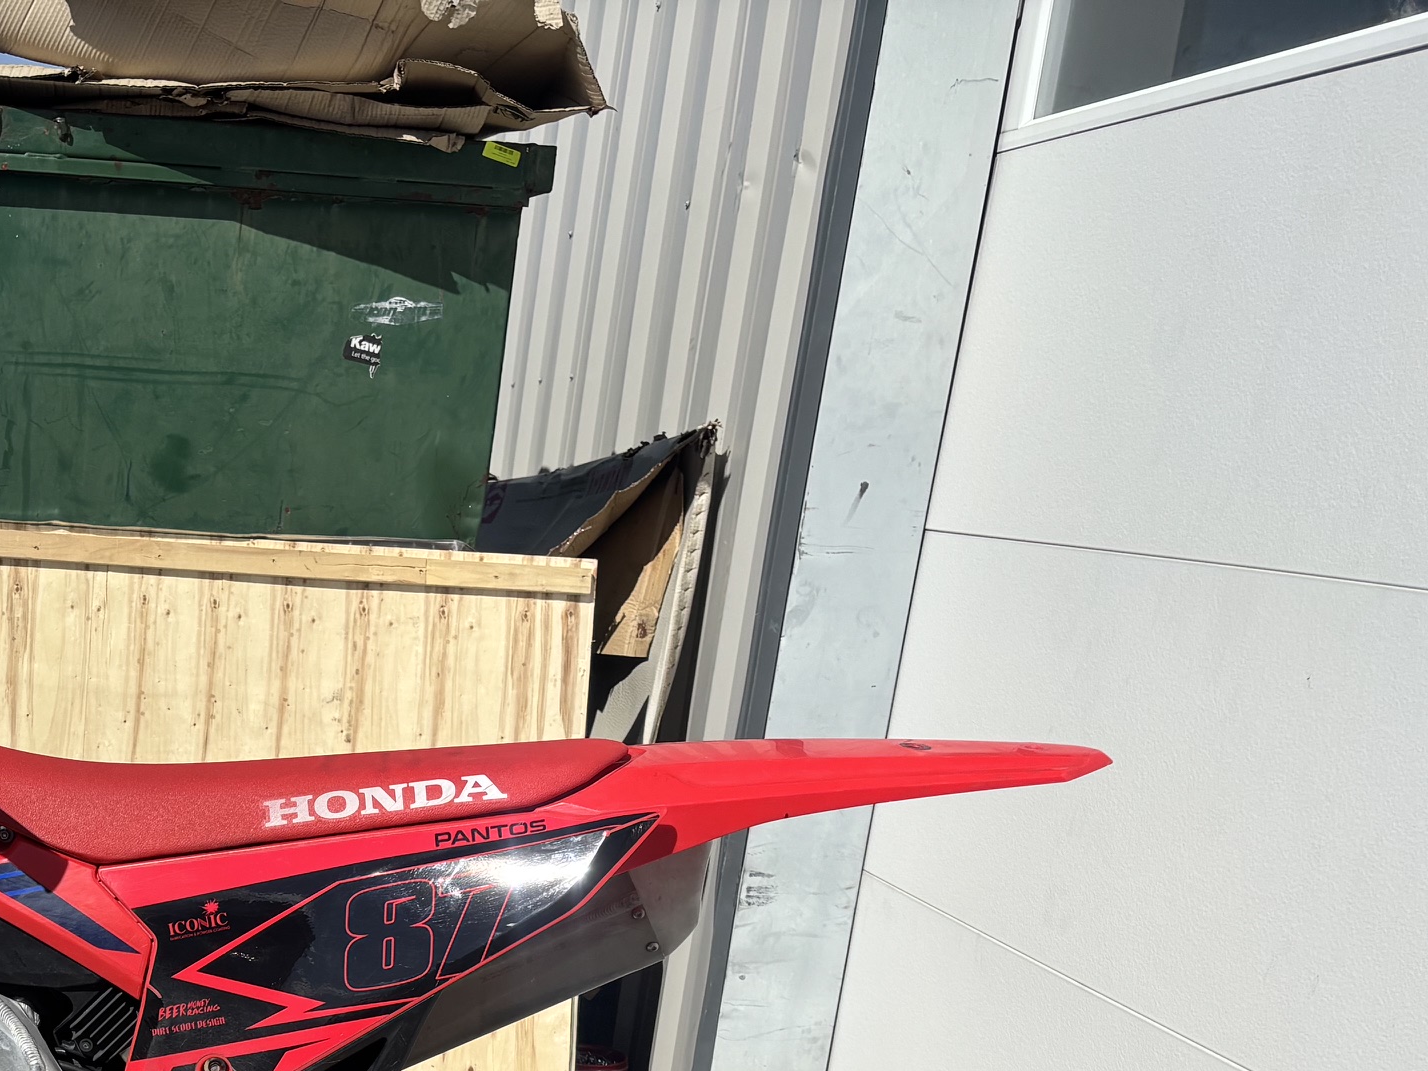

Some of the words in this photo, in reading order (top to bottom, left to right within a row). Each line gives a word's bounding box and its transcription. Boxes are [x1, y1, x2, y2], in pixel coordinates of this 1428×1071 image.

[264, 774, 507, 828] HONDA
[434, 819, 548, 848] PANTOS
[168, 912, 229, 936] ICONIC
[344, 878, 515, 992] 87
[158, 1003, 188, 1021] BEER
[187, 1004, 221, 1017] RACING
[152, 1026, 170, 1037] DIRT
[172, 1022, 196, 1034] SCOOT
[197, 1017, 226, 1029] DESIGN
